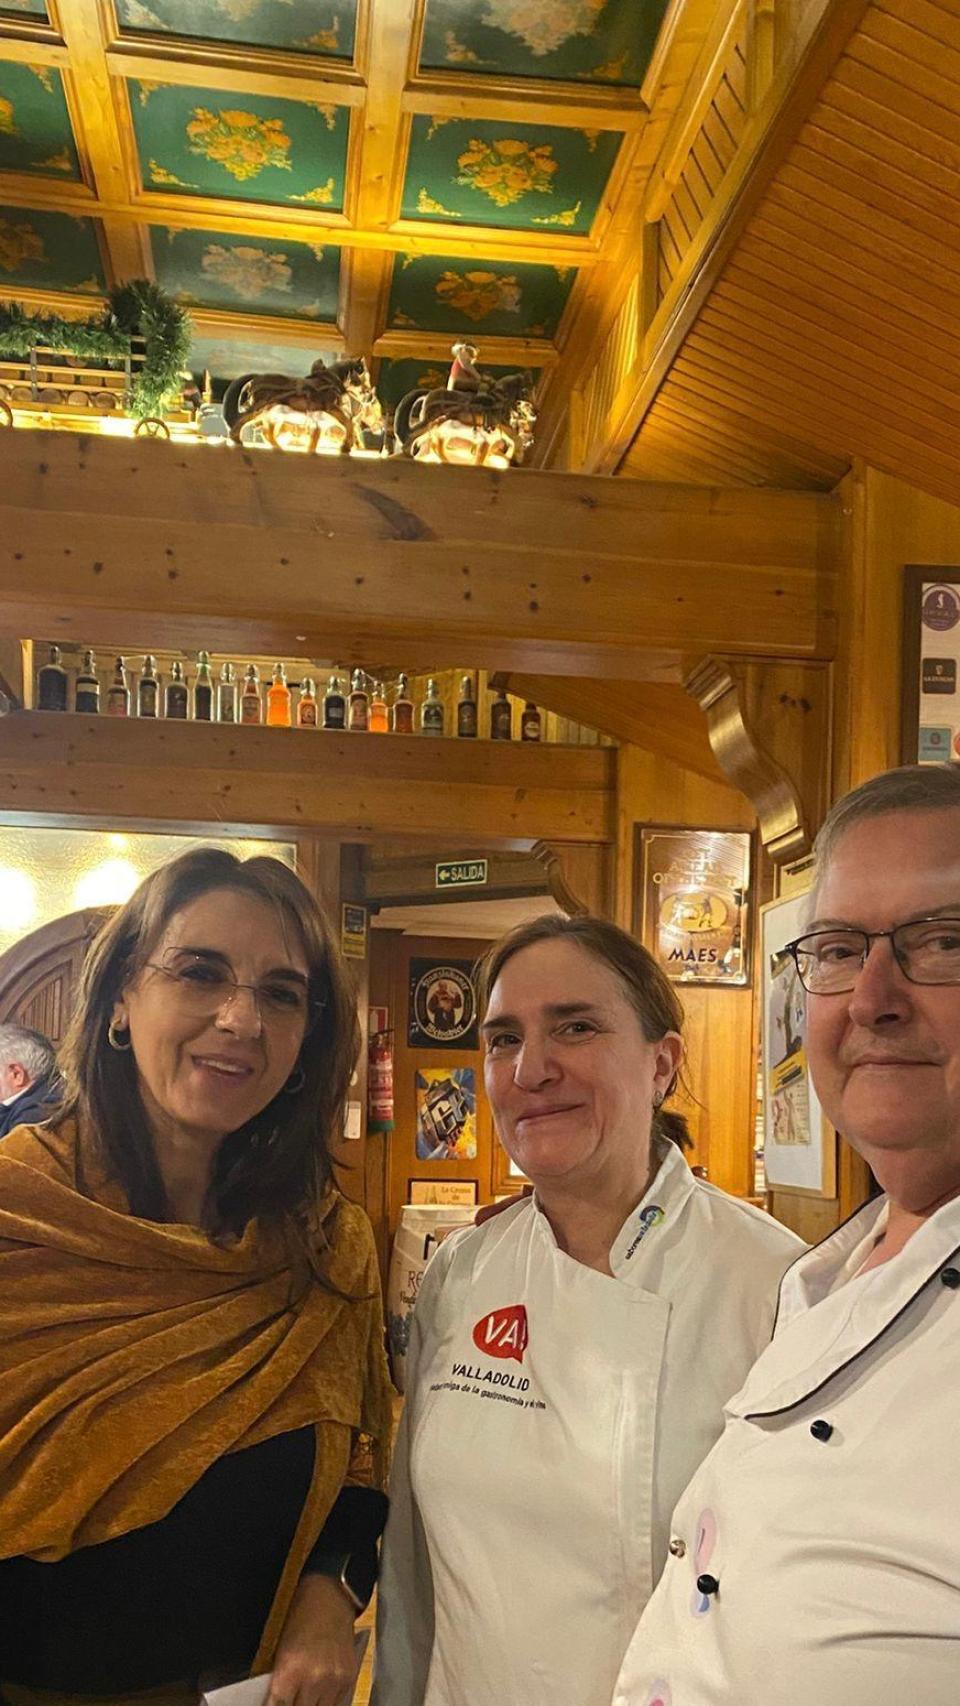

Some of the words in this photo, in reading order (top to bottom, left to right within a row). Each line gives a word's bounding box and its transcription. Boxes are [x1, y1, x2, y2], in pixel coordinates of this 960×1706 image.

[451, 865, 484, 881] SALIDA
[668, 948, 717, 963] MAES
[485, 1316, 526, 1350] VA!
[451, 1363, 530, 1392] VALLADOLID
[461, 1383, 471, 1393] de
